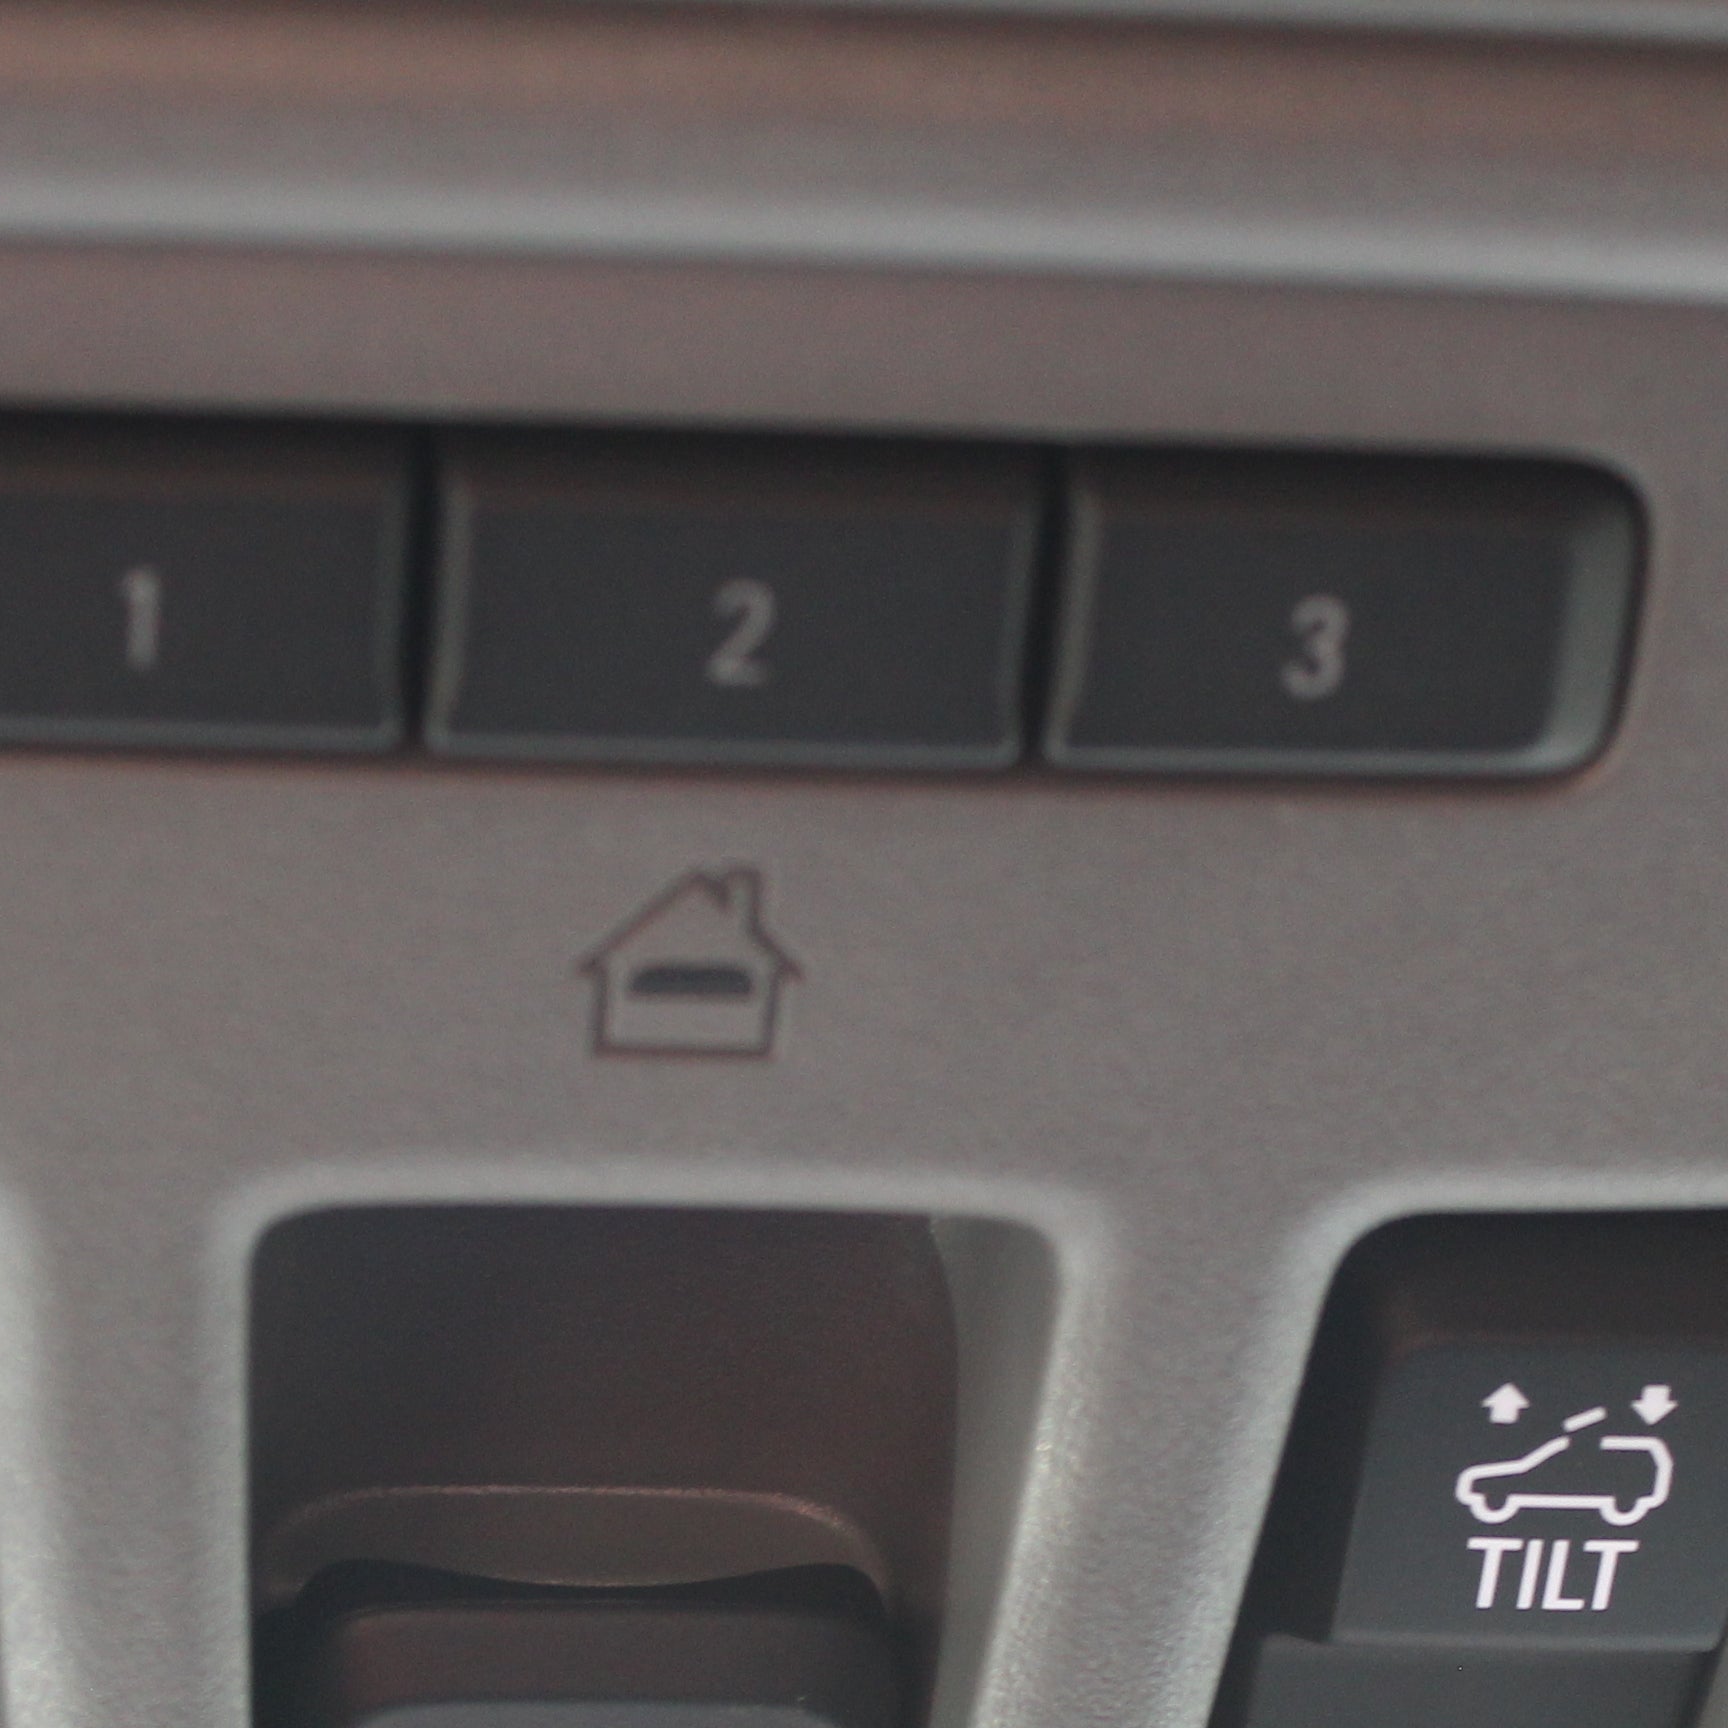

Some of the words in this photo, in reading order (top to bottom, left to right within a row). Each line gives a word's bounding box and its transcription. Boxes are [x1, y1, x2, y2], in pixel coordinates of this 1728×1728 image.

[118, 565, 163, 673] 1
[704, 577, 778, 688] 2
[1280, 594, 1351, 701] 3
[1467, 1536, 1640, 1611] TILT
